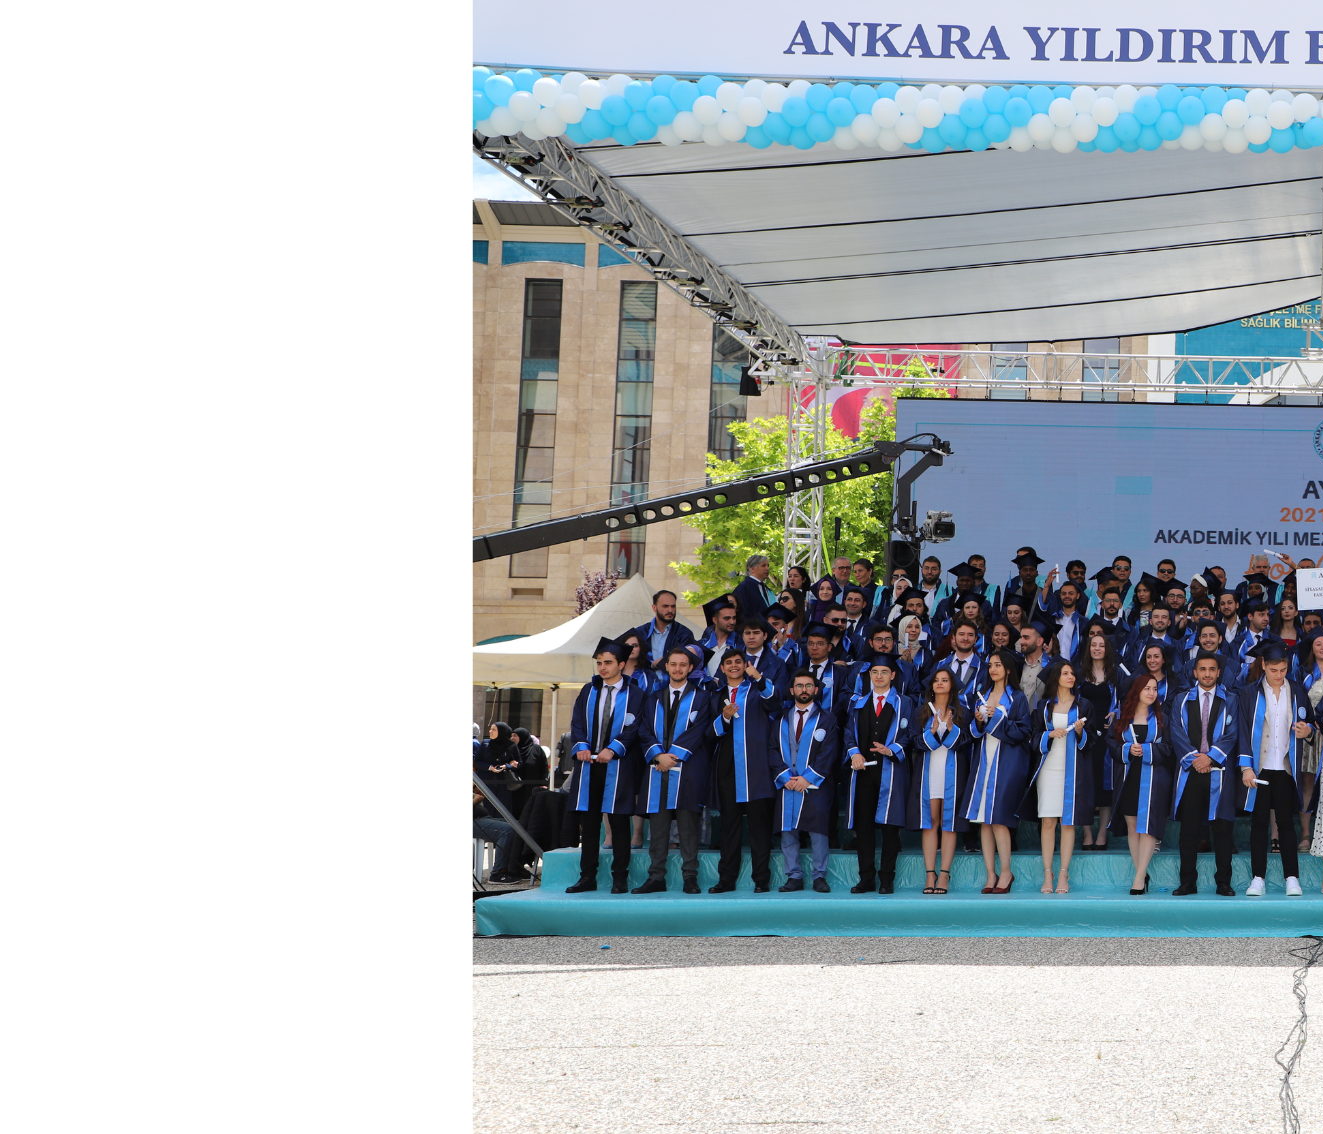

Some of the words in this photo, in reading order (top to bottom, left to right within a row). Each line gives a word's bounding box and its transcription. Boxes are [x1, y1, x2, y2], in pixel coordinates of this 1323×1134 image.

[782, 20, 1011, 61] ANKARA
[1022, 26, 1290, 65] YILDIRIM
[1240, 316, 1281, 328] SAĞLIK
[1154, 528, 1252, 546] AKADEMİK
[1256, 531, 1289, 546] YILI
